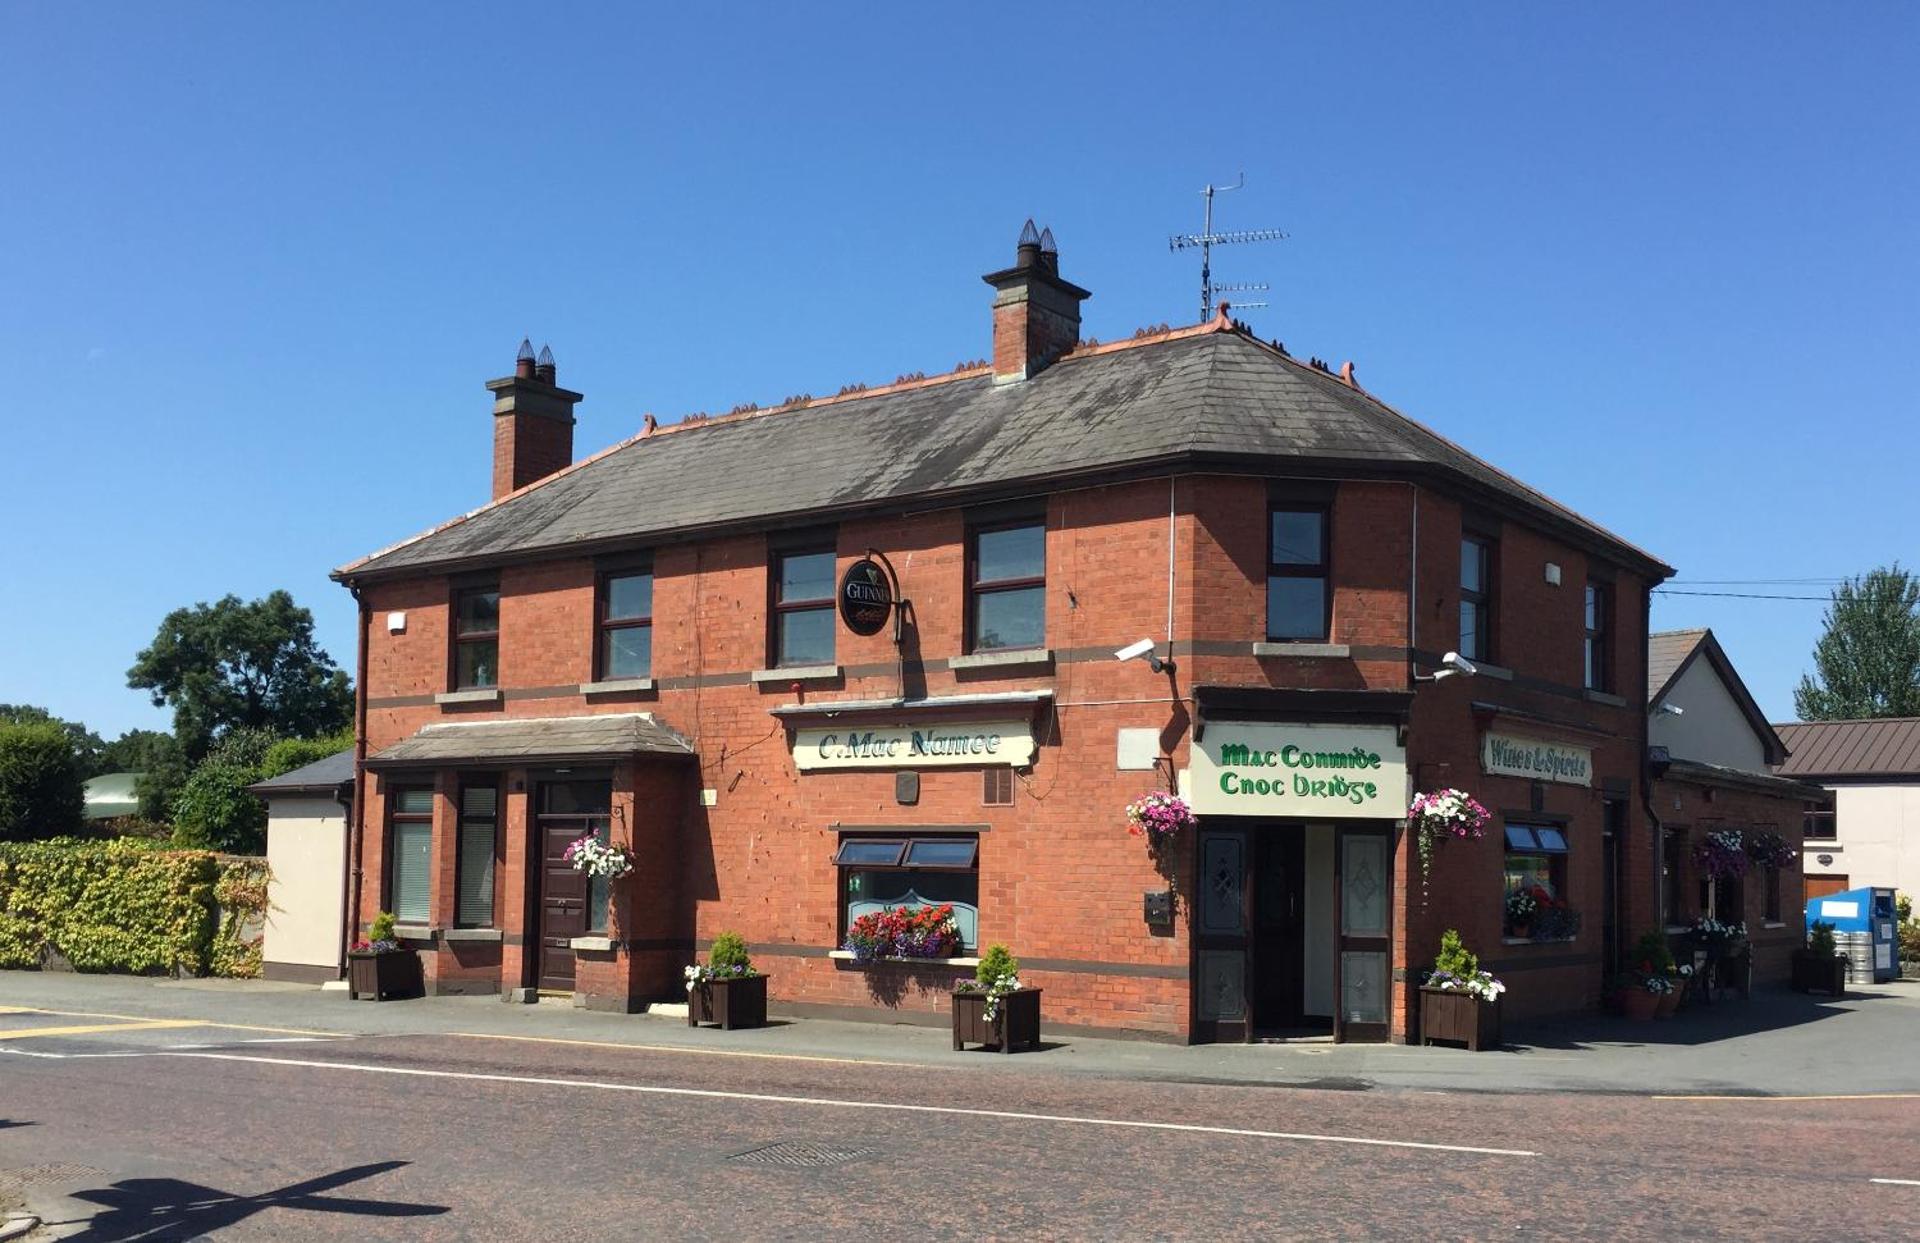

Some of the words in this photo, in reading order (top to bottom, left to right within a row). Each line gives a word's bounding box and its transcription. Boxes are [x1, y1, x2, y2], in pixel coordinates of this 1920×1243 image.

[846, 583, 891, 602] GUINN
[907, 730, 1001, 758] Namee
[1221, 743, 1278, 767] Mac
[1220, 771, 1285, 796] Cnoc
